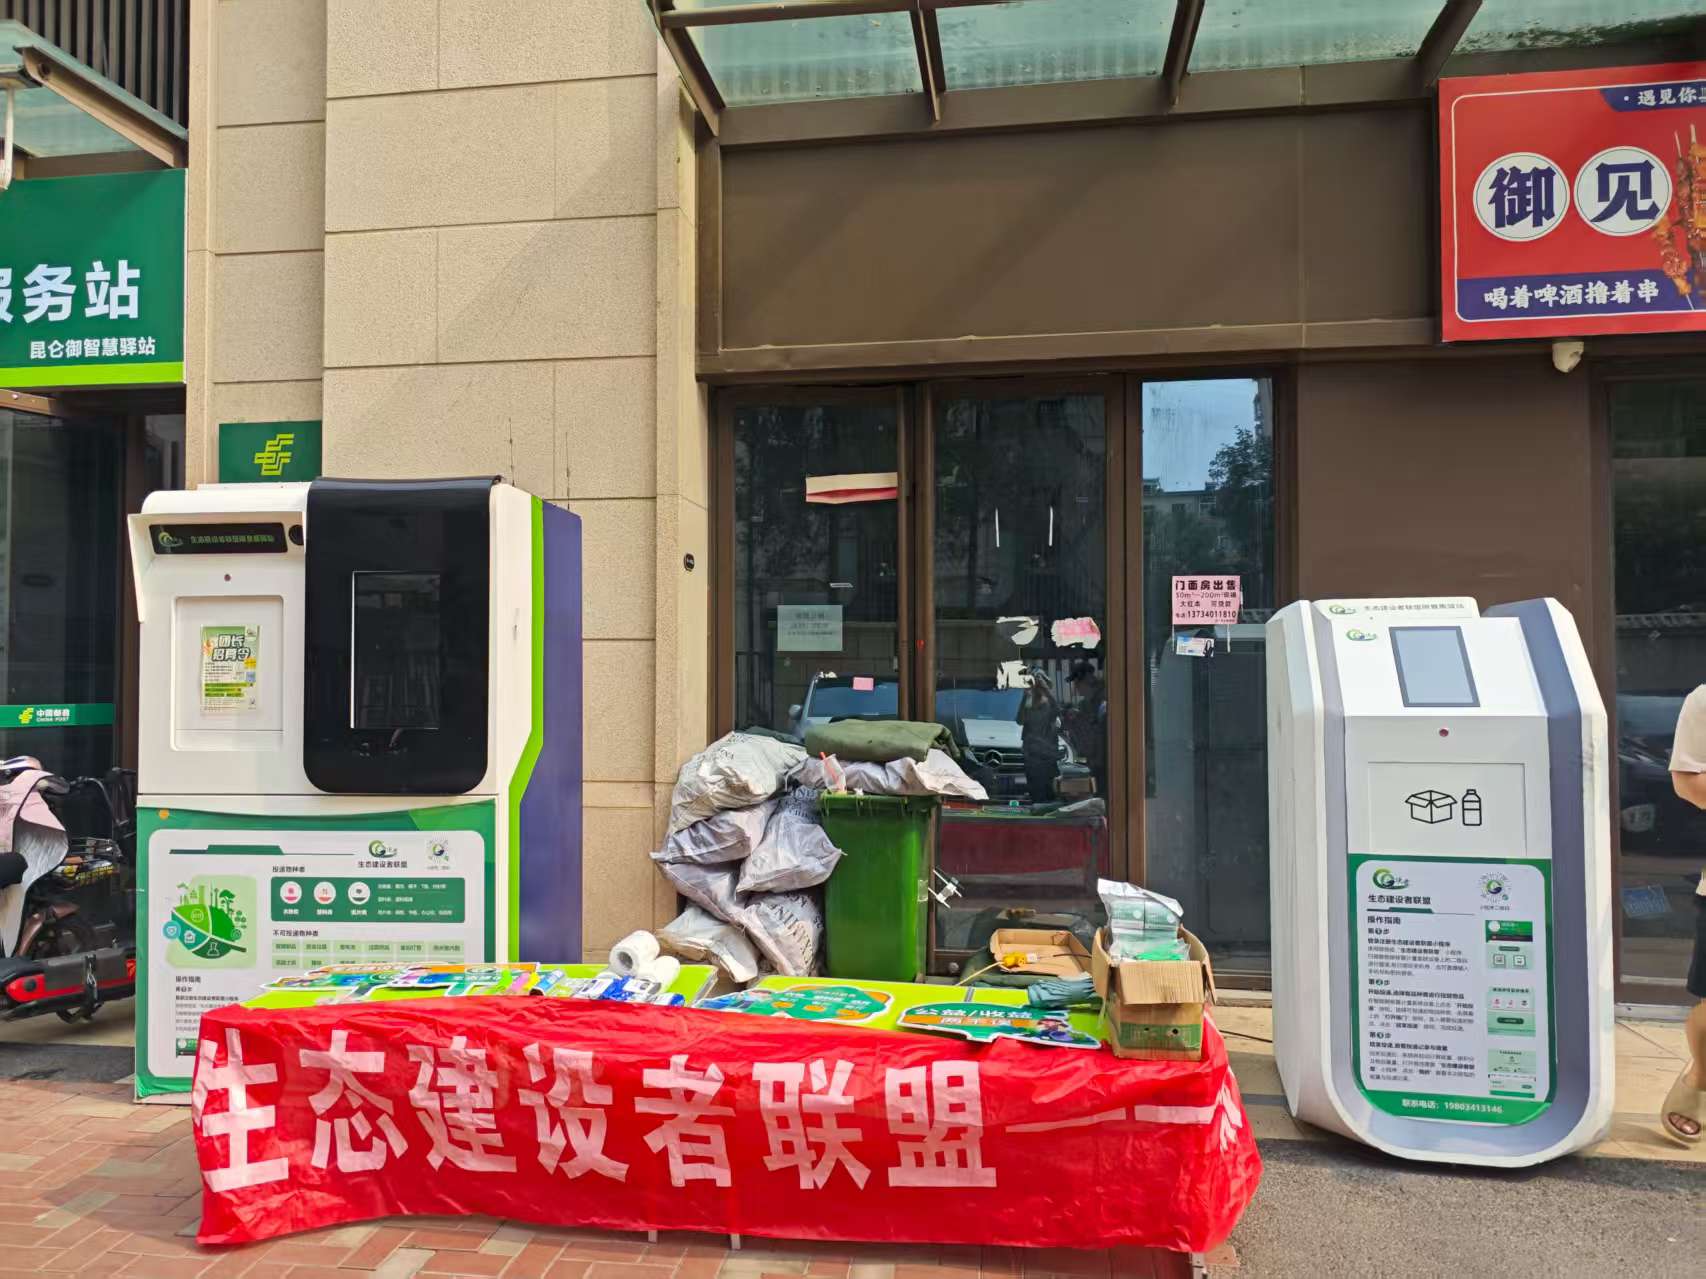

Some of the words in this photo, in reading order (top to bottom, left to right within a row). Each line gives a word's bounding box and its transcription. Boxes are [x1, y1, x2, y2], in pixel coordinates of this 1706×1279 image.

[1488, 159, 1661, 229] 御见
[0, 260, 141, 323] 务站
[1484, 279, 1659, 310] 喝着啤酒撸着串
[30, 336, 156, 359] 昆仑御智慧驿站
[1175, 579, 1236, 591] 门面房出售
[1187, 610, 1237, 618] 13734011810
[1368, 894, 1431, 905] 生态建设者联盟
[1367, 916, 1401, 925] 操作指南
